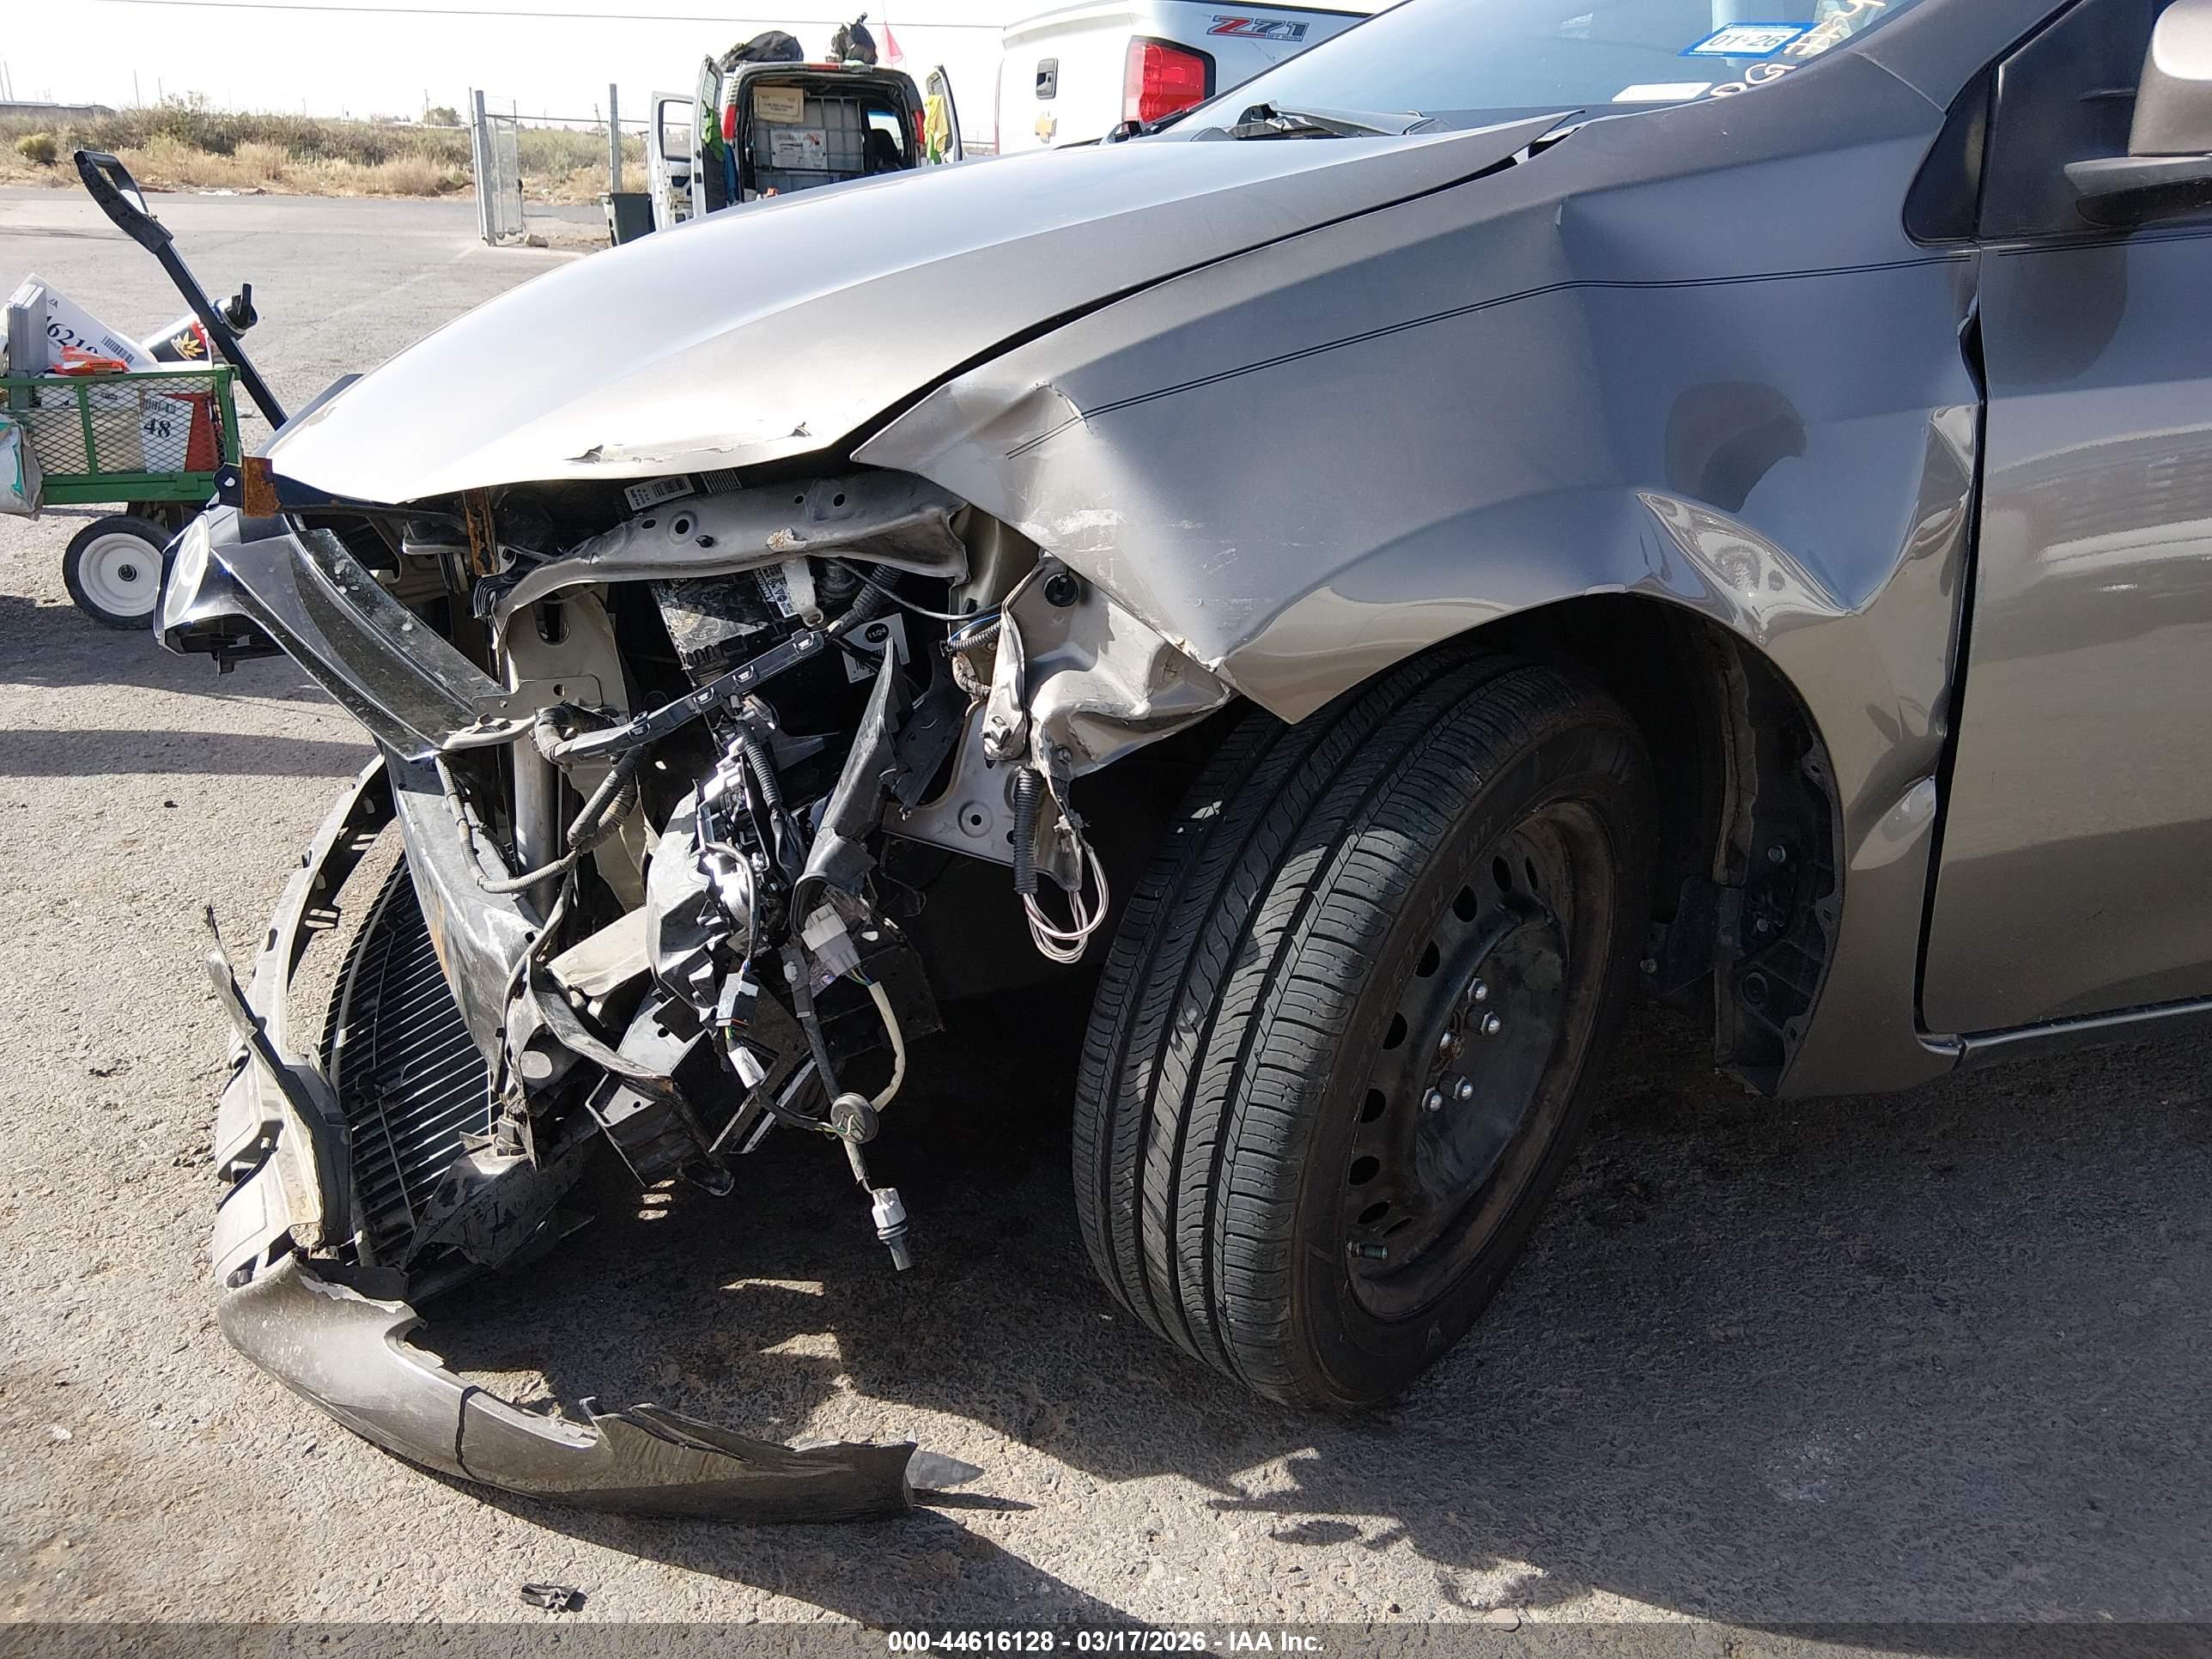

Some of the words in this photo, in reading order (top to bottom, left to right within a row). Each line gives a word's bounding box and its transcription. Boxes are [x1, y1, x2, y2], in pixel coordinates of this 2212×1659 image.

[1206, 15, 1310, 41] Z71
[143, 418, 171, 438] 48
[867, 627, 887, 639] 11/24
